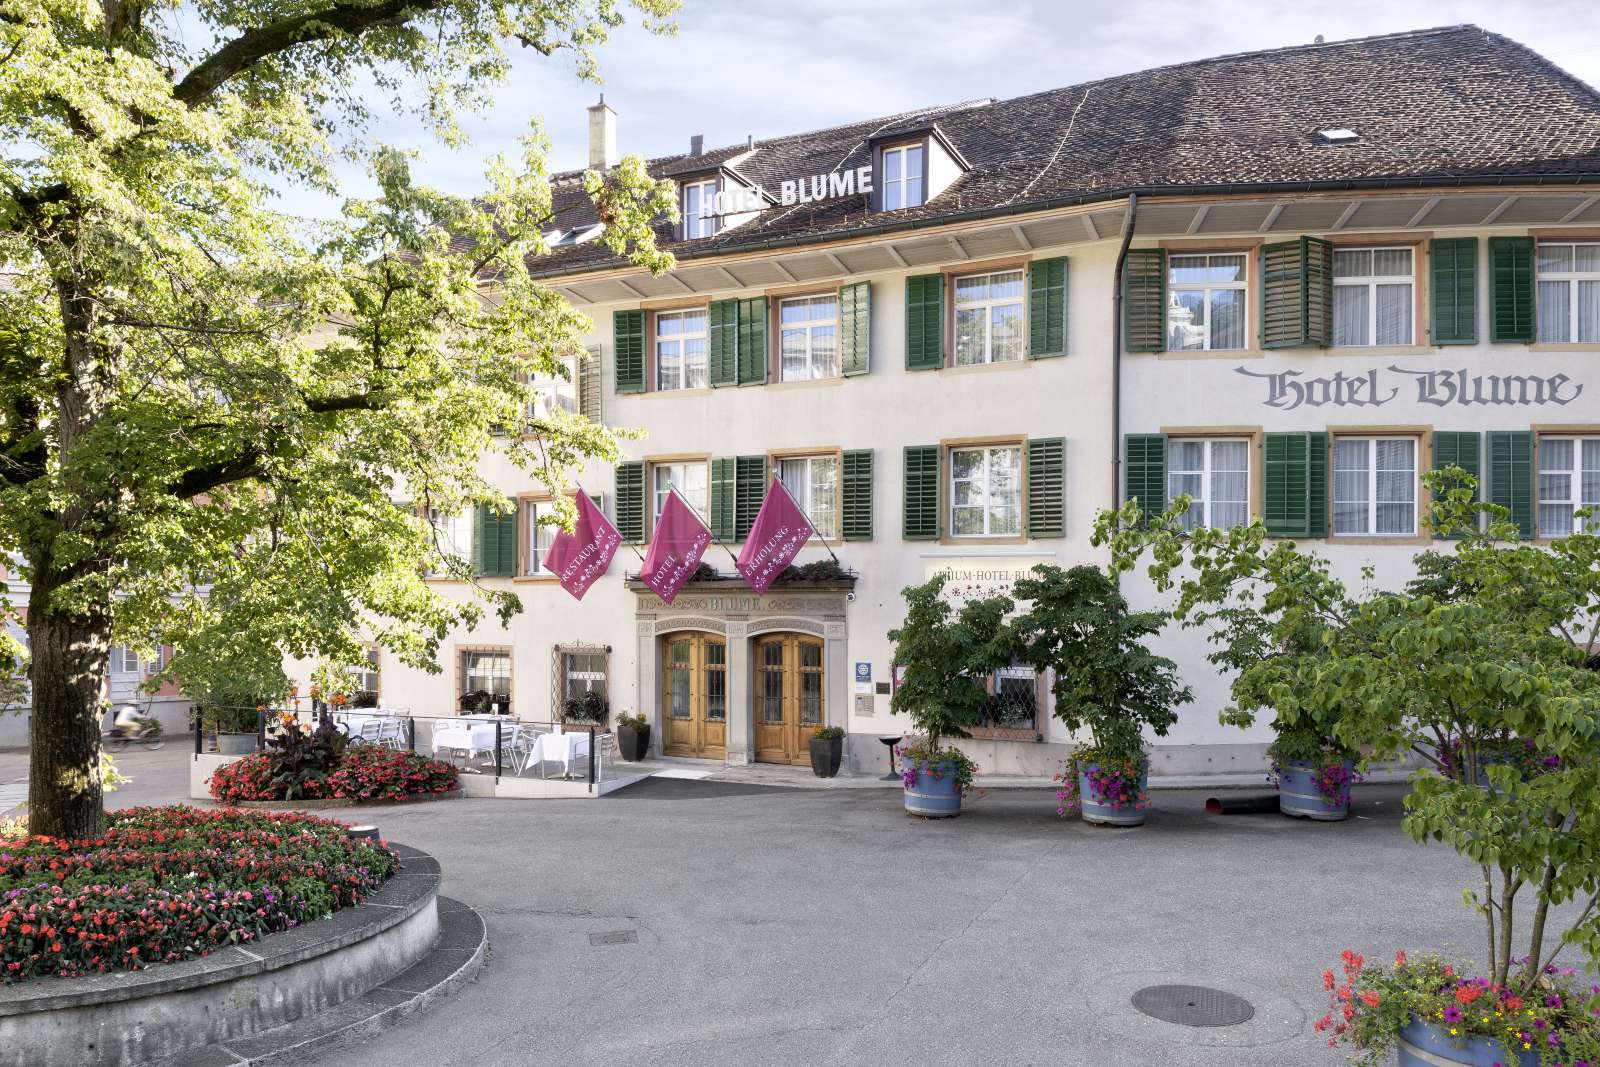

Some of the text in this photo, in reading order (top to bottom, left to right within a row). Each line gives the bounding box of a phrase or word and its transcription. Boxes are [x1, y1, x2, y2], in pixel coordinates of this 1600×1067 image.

[701, 165, 873, 217] HOTEL BLUME
[1232, 363, 1584, 411] Hotel Blume
[561, 526, 606, 582] RESTAURANT
[651, 555, 677, 587] HOTEL
[745, 526, 790, 577] ERHOLUNG
[707, 597, 761, 610] BLUME
